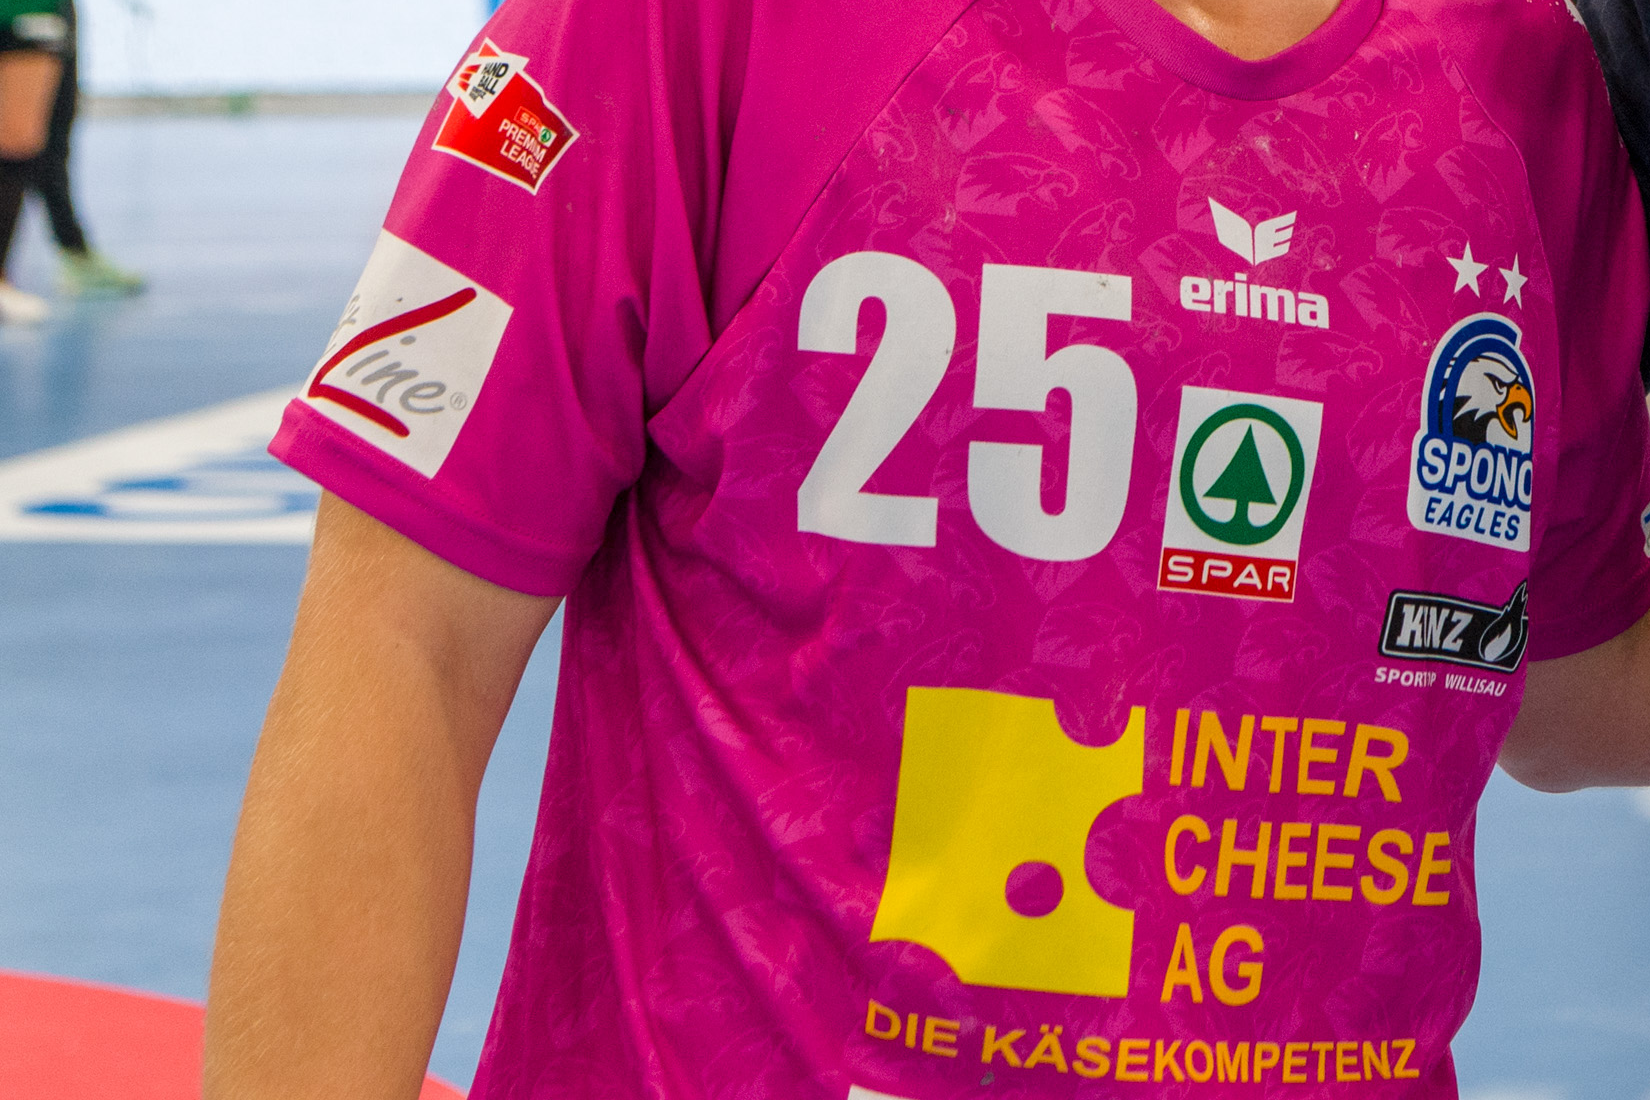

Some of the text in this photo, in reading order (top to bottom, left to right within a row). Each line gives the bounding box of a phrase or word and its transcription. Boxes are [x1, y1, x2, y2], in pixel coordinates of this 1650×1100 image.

[519, 111, 541, 133] SPA
[500, 139, 541, 179] LEAGE
[1180, 272, 1330, 329] erima
[798, 251, 1137, 562] 25
[1421, 437, 1533, 505] SPONO
[1424, 497, 1520, 541] EAGLES
[1166, 554, 1291, 593] SPAR
[1444, 673, 1507, 697] WILLISAU
[1169, 708, 1409, 803] INTER
[1164, 814, 1451, 906] CHEESE
[1160, 922, 1264, 1006] AG
[864, 999, 1420, 1084] DIE KÄSEKOMPETENZ
